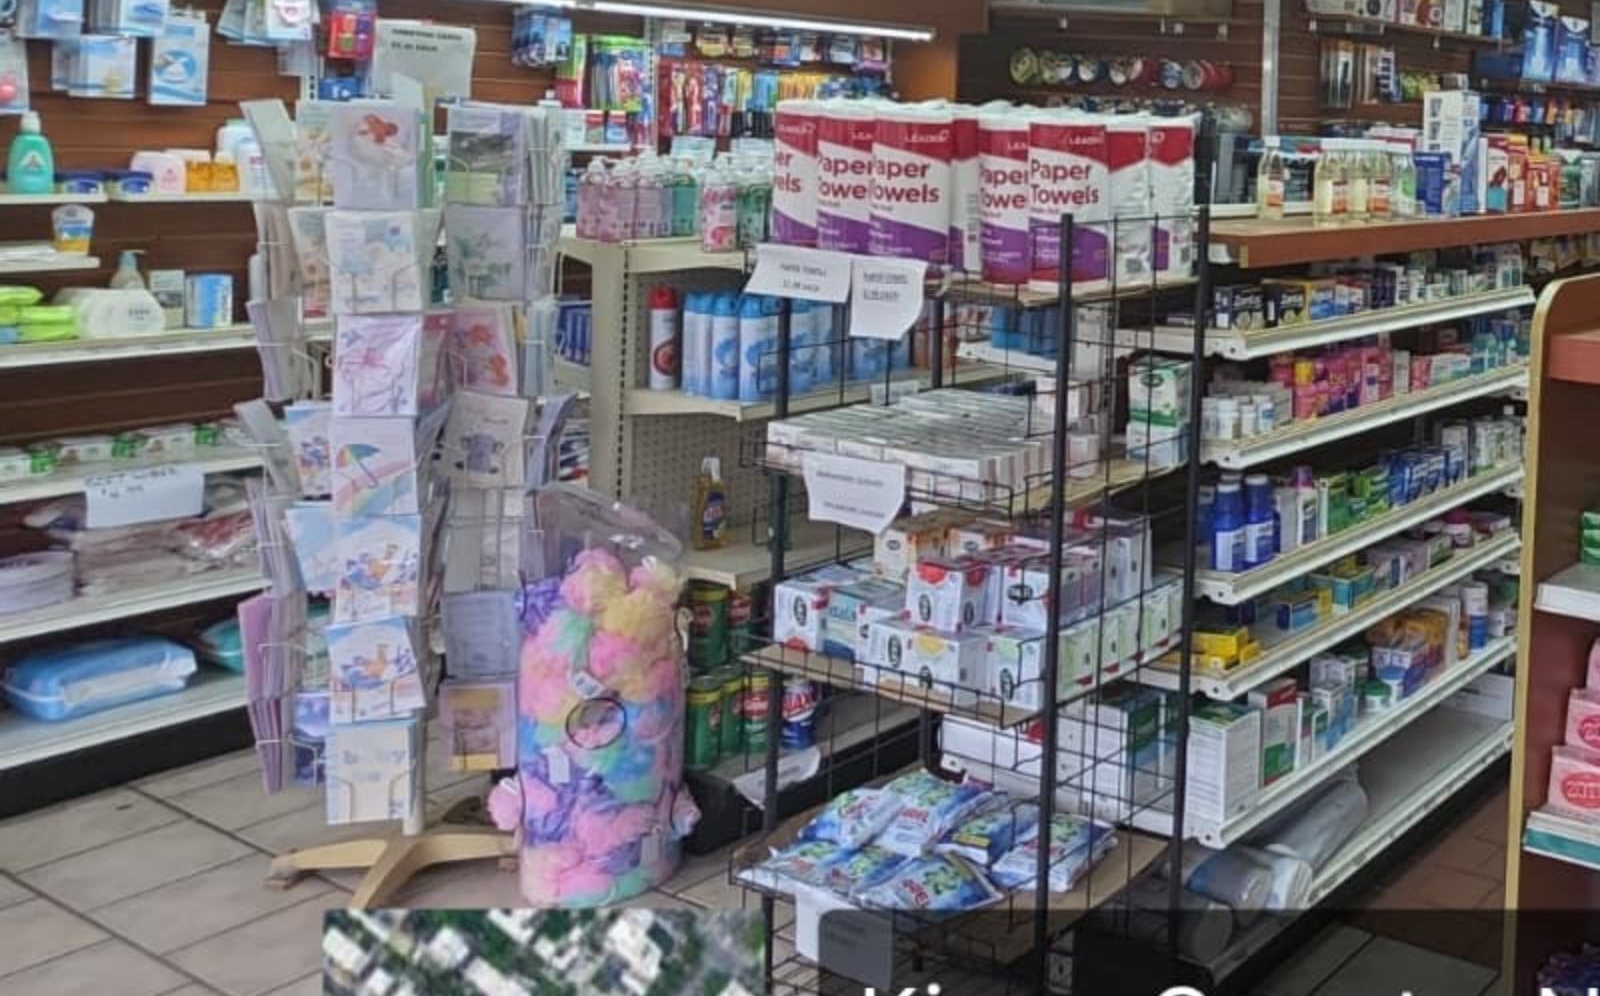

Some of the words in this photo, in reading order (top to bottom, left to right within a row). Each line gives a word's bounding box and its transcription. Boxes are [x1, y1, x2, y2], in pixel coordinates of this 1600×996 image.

[818, 155, 873, 178] aper
[980, 162, 1028, 188] aper
[1030, 158, 1092, 184] Paper
[871, 178, 940, 204] owels
[1031, 184, 1100, 206] Towels
